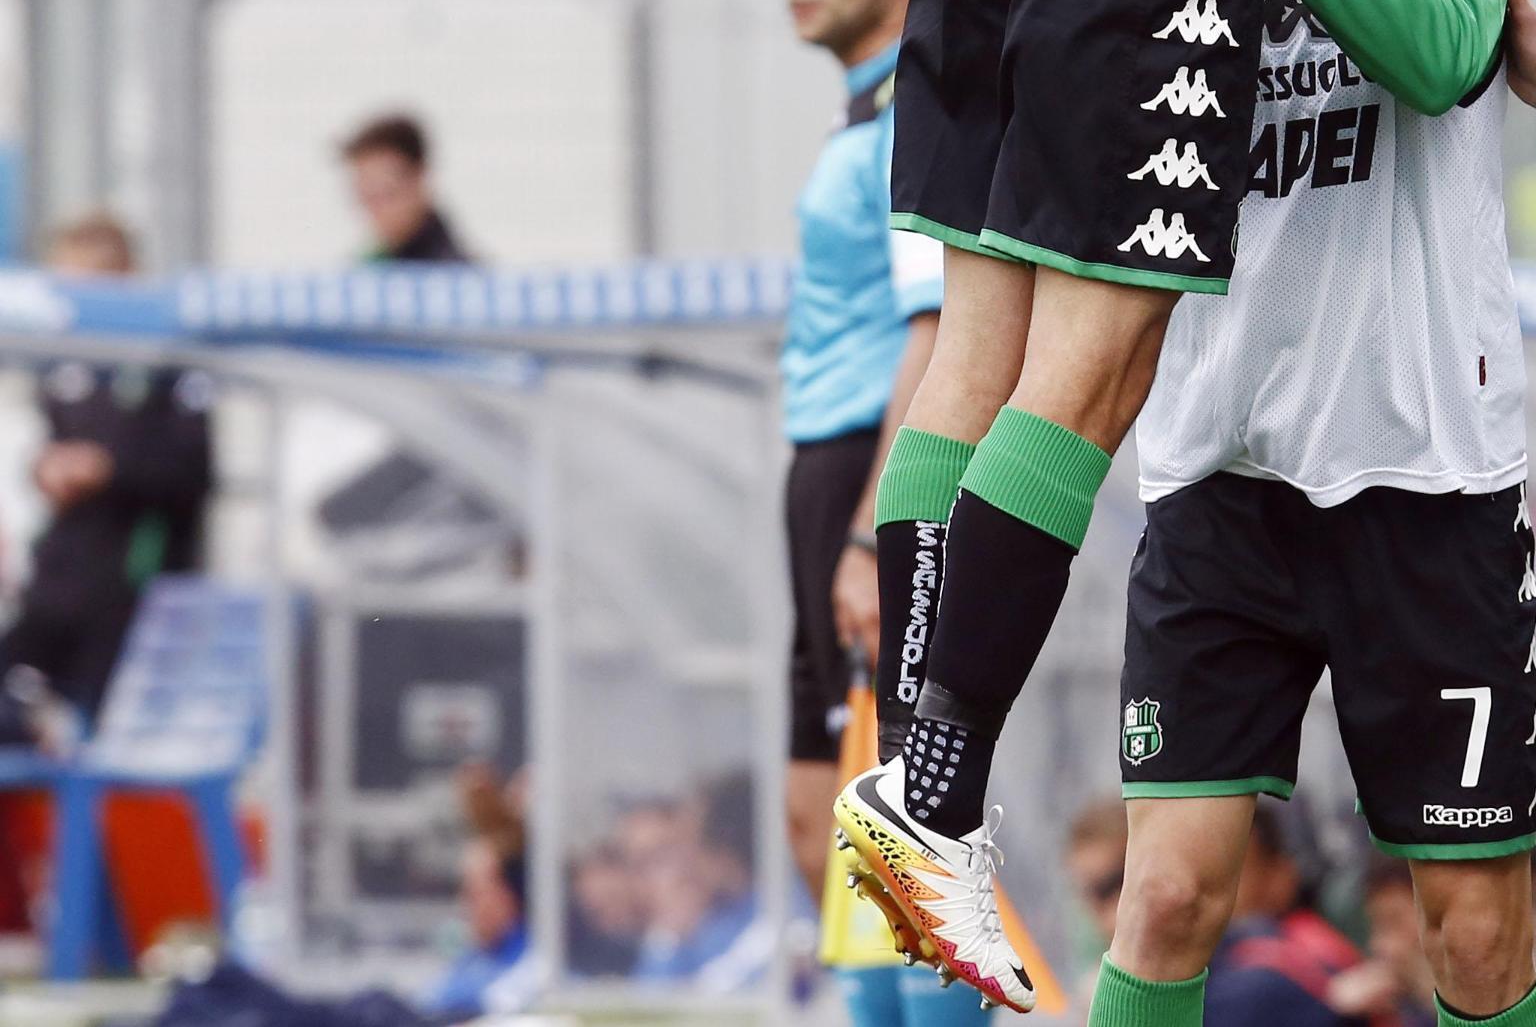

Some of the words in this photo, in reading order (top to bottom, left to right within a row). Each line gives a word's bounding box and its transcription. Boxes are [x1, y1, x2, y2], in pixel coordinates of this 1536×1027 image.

[1246, 104, 1380, 199] APEI
[1440, 686, 1492, 788] 7
[1423, 804, 1513, 828] Kappa
